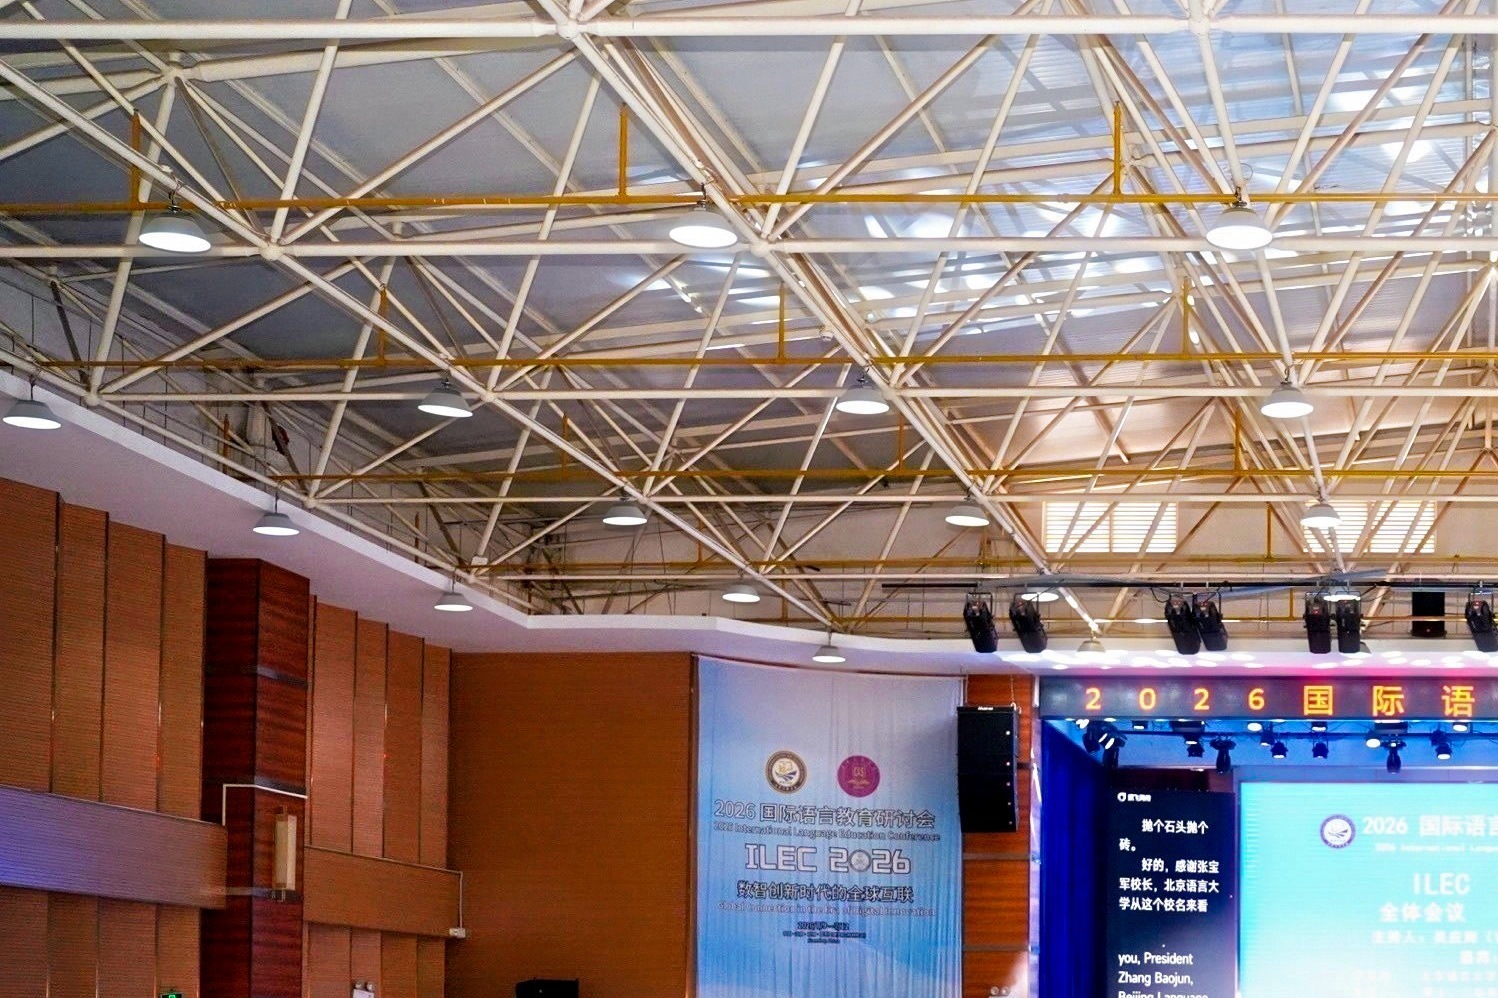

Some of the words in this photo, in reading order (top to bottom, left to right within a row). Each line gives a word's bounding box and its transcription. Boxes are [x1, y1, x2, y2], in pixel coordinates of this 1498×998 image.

[714, 799, 756, 819] 2026
[760, 803, 936, 828] 国际语言教育研讨会
[735, 824, 792, 836] International
[793, 827, 838, 840] Language
[840, 829, 886, 840] Education
[888, 831, 940, 842] Conference
[1141, 818, 1209, 835] 抛个石头抛个
[1363, 815, 1408, 835] 2026
[745, 843, 817, 872] ILEC
[1141, 857, 1220, 873] 好的，感谢张宝
[737, 880, 914, 903] 数智创新时代的全球互联
[1119, 877, 1220, 893] 军校长，北京语言大
[1413, 872, 1471, 896] ILEC
[1118, 896, 1208, 912] 学从这个校名来看
[1379, 902, 1466, 924] 全体会议
[1118, 953, 1141, 966] you,
[1143, 951, 1193, 965] President
[1118, 971, 1152, 987] Zhang
[1154, 971, 1193, 987] Baojun,
